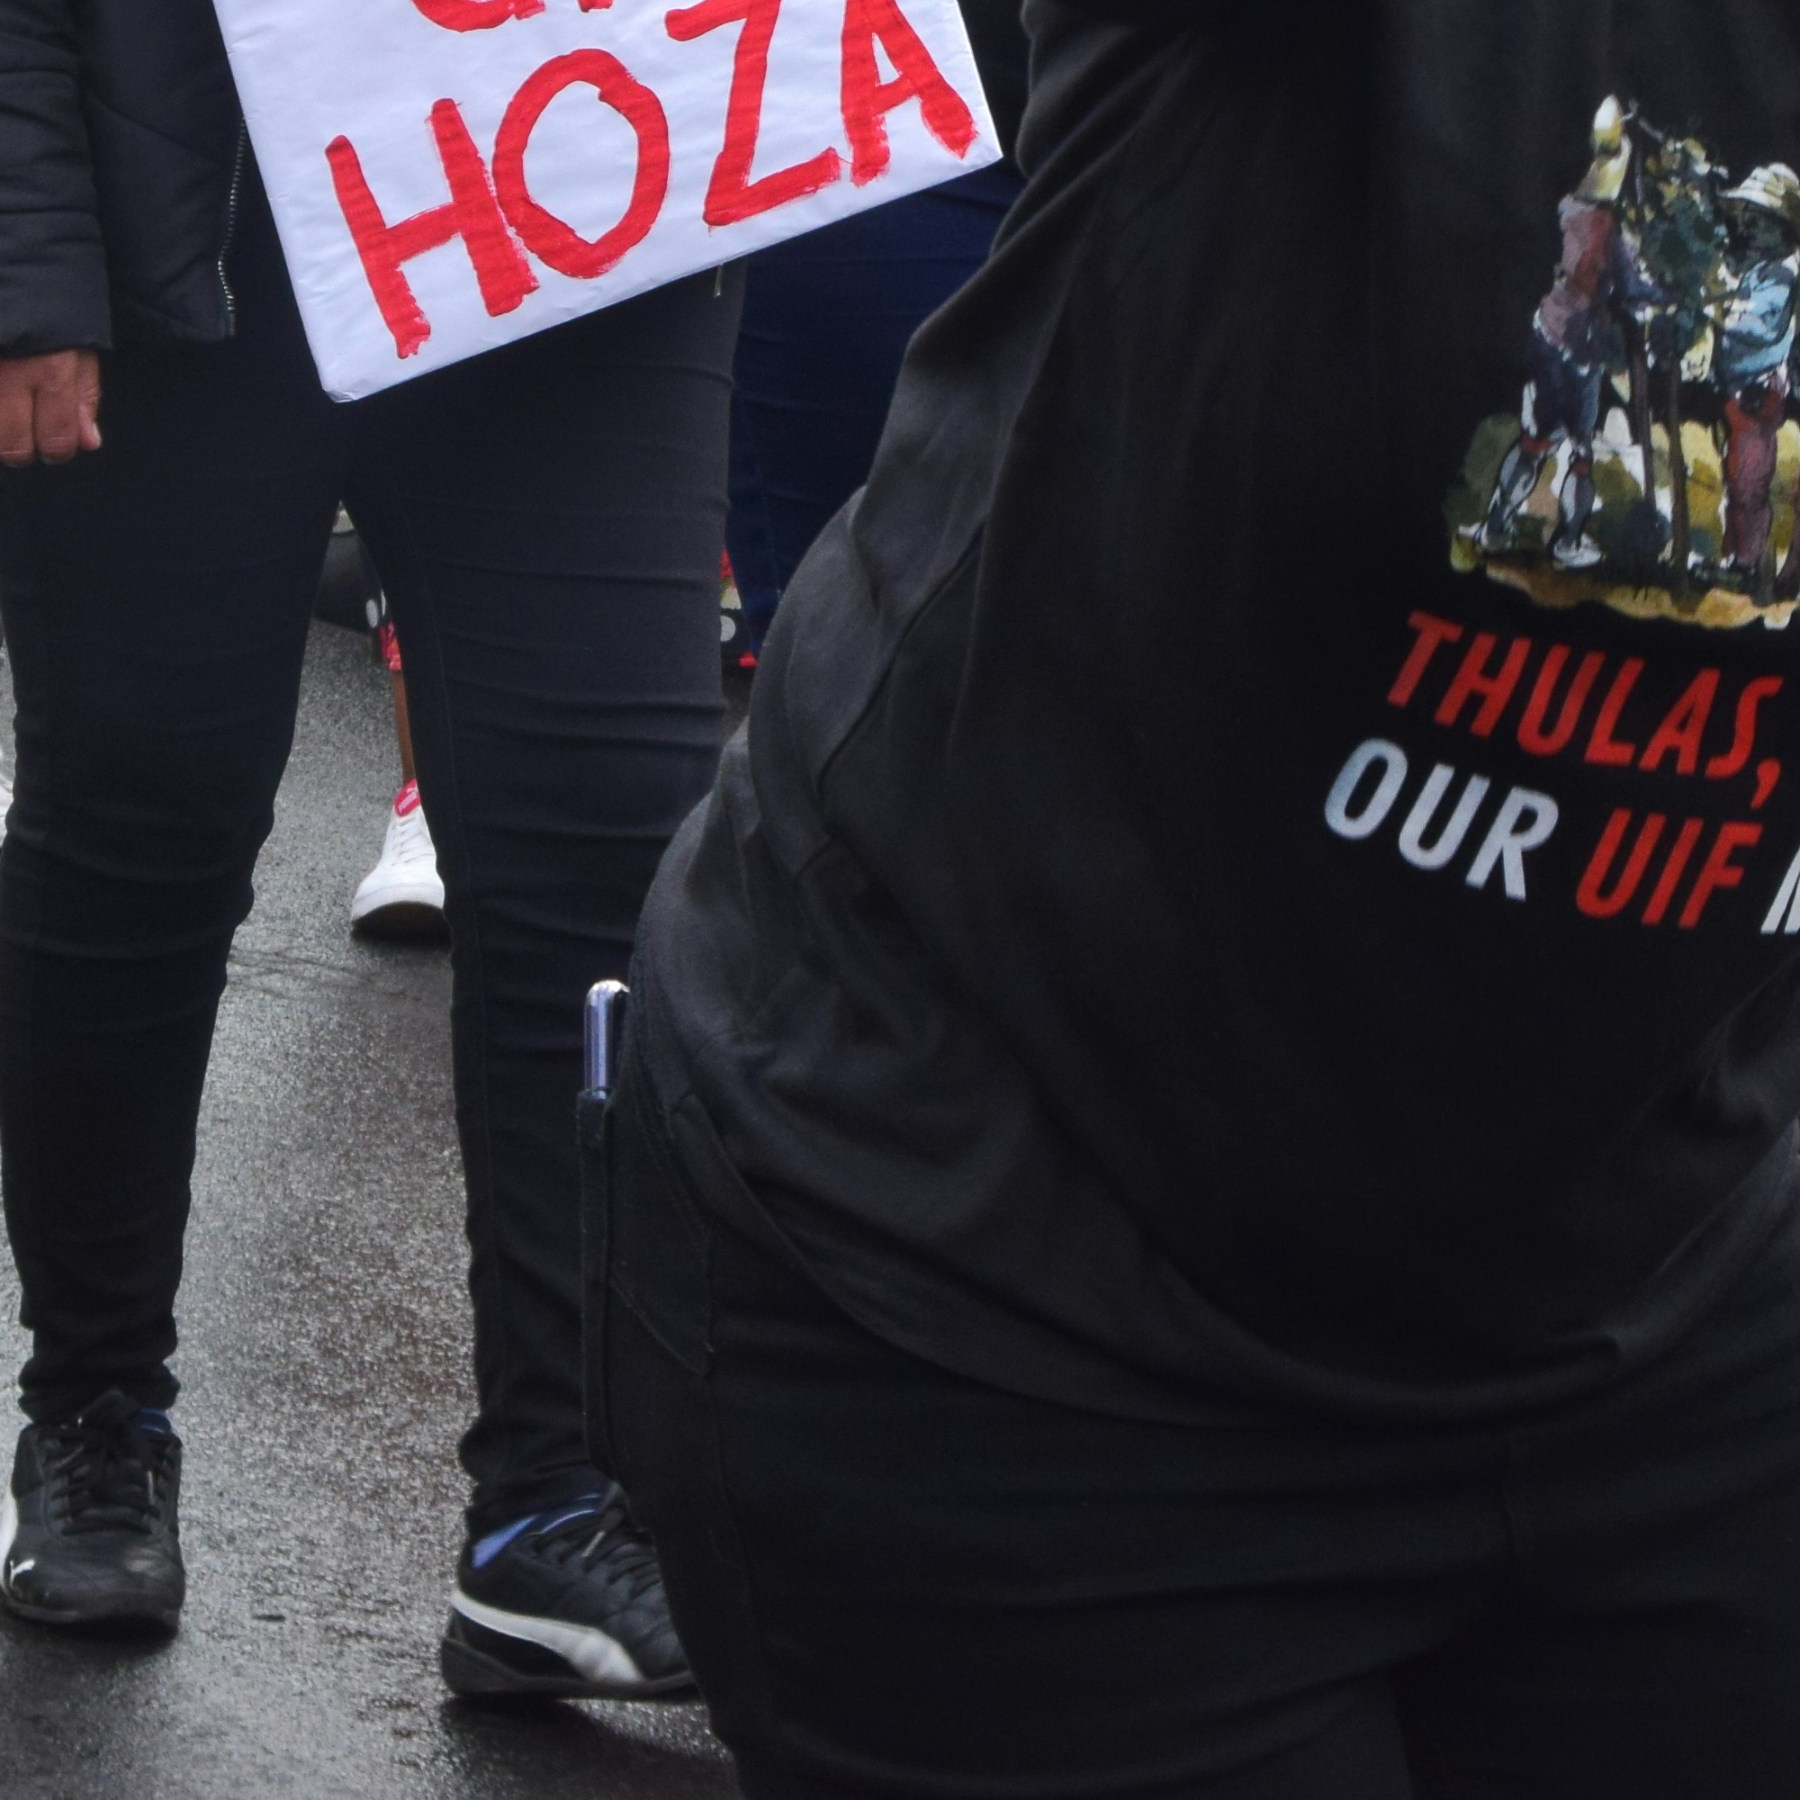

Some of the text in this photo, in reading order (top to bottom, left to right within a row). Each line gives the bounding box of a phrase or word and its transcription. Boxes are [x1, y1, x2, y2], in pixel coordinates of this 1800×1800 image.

[1387, 611, 1784, 810] THULAS,
[1324, 737, 1559, 902] OUR
[1575, 808, 1763, 930] UIF
